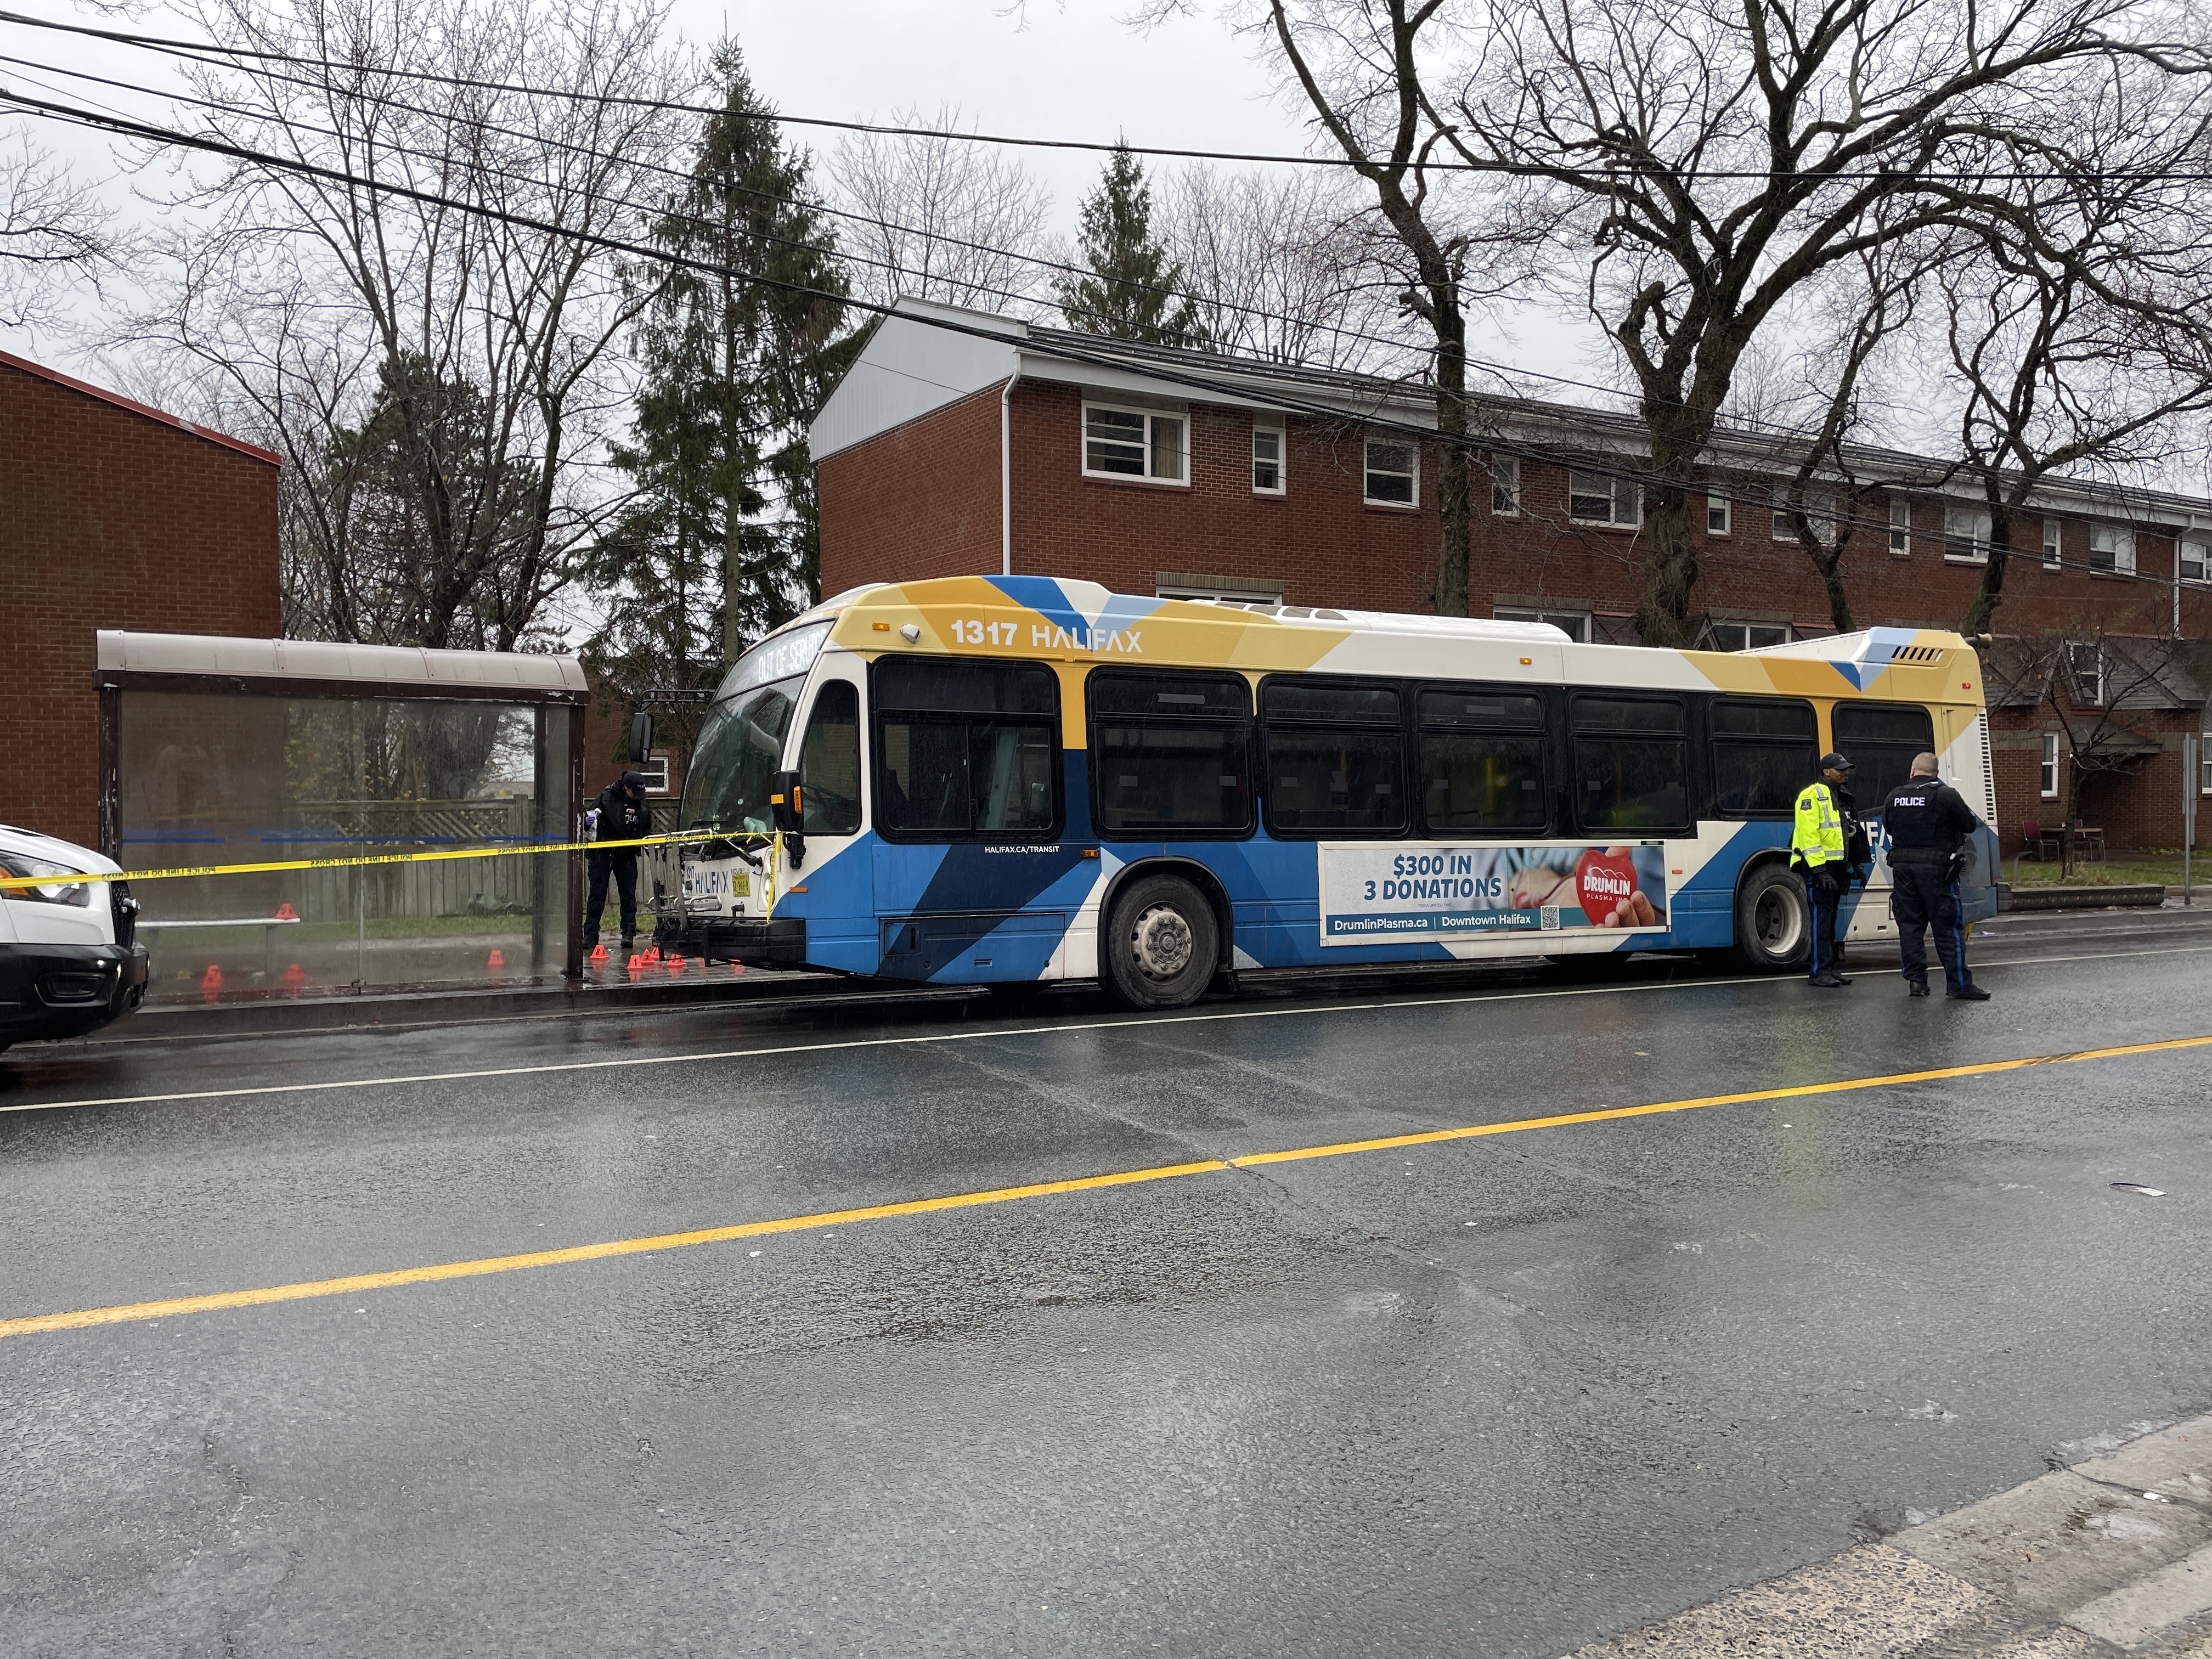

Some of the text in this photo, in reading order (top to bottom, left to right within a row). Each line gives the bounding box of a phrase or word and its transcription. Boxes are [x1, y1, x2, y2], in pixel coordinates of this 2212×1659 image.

[951, 619, 1017, 646] 1317
[1031, 624, 1143, 653] HALIFAX
[758, 651, 774, 684] OUT
[776, 645, 787, 676] OF
[1894, 797, 1926, 806] POLICE
[985, 845, 1060, 854] HALIFAX.CA/TRANSIT
[1393, 854, 1472, 879] $300 IN
[695, 871, 730, 894] HALIFAX
[1364, 878, 1502, 900] 3 DONATIONS
[1584, 875, 1630, 895] DRUMLIN
[1587, 893, 1613, 901] PLASMA
[1334, 913, 1531, 931] DrumlinPlasma.ca Downtown Halifax
